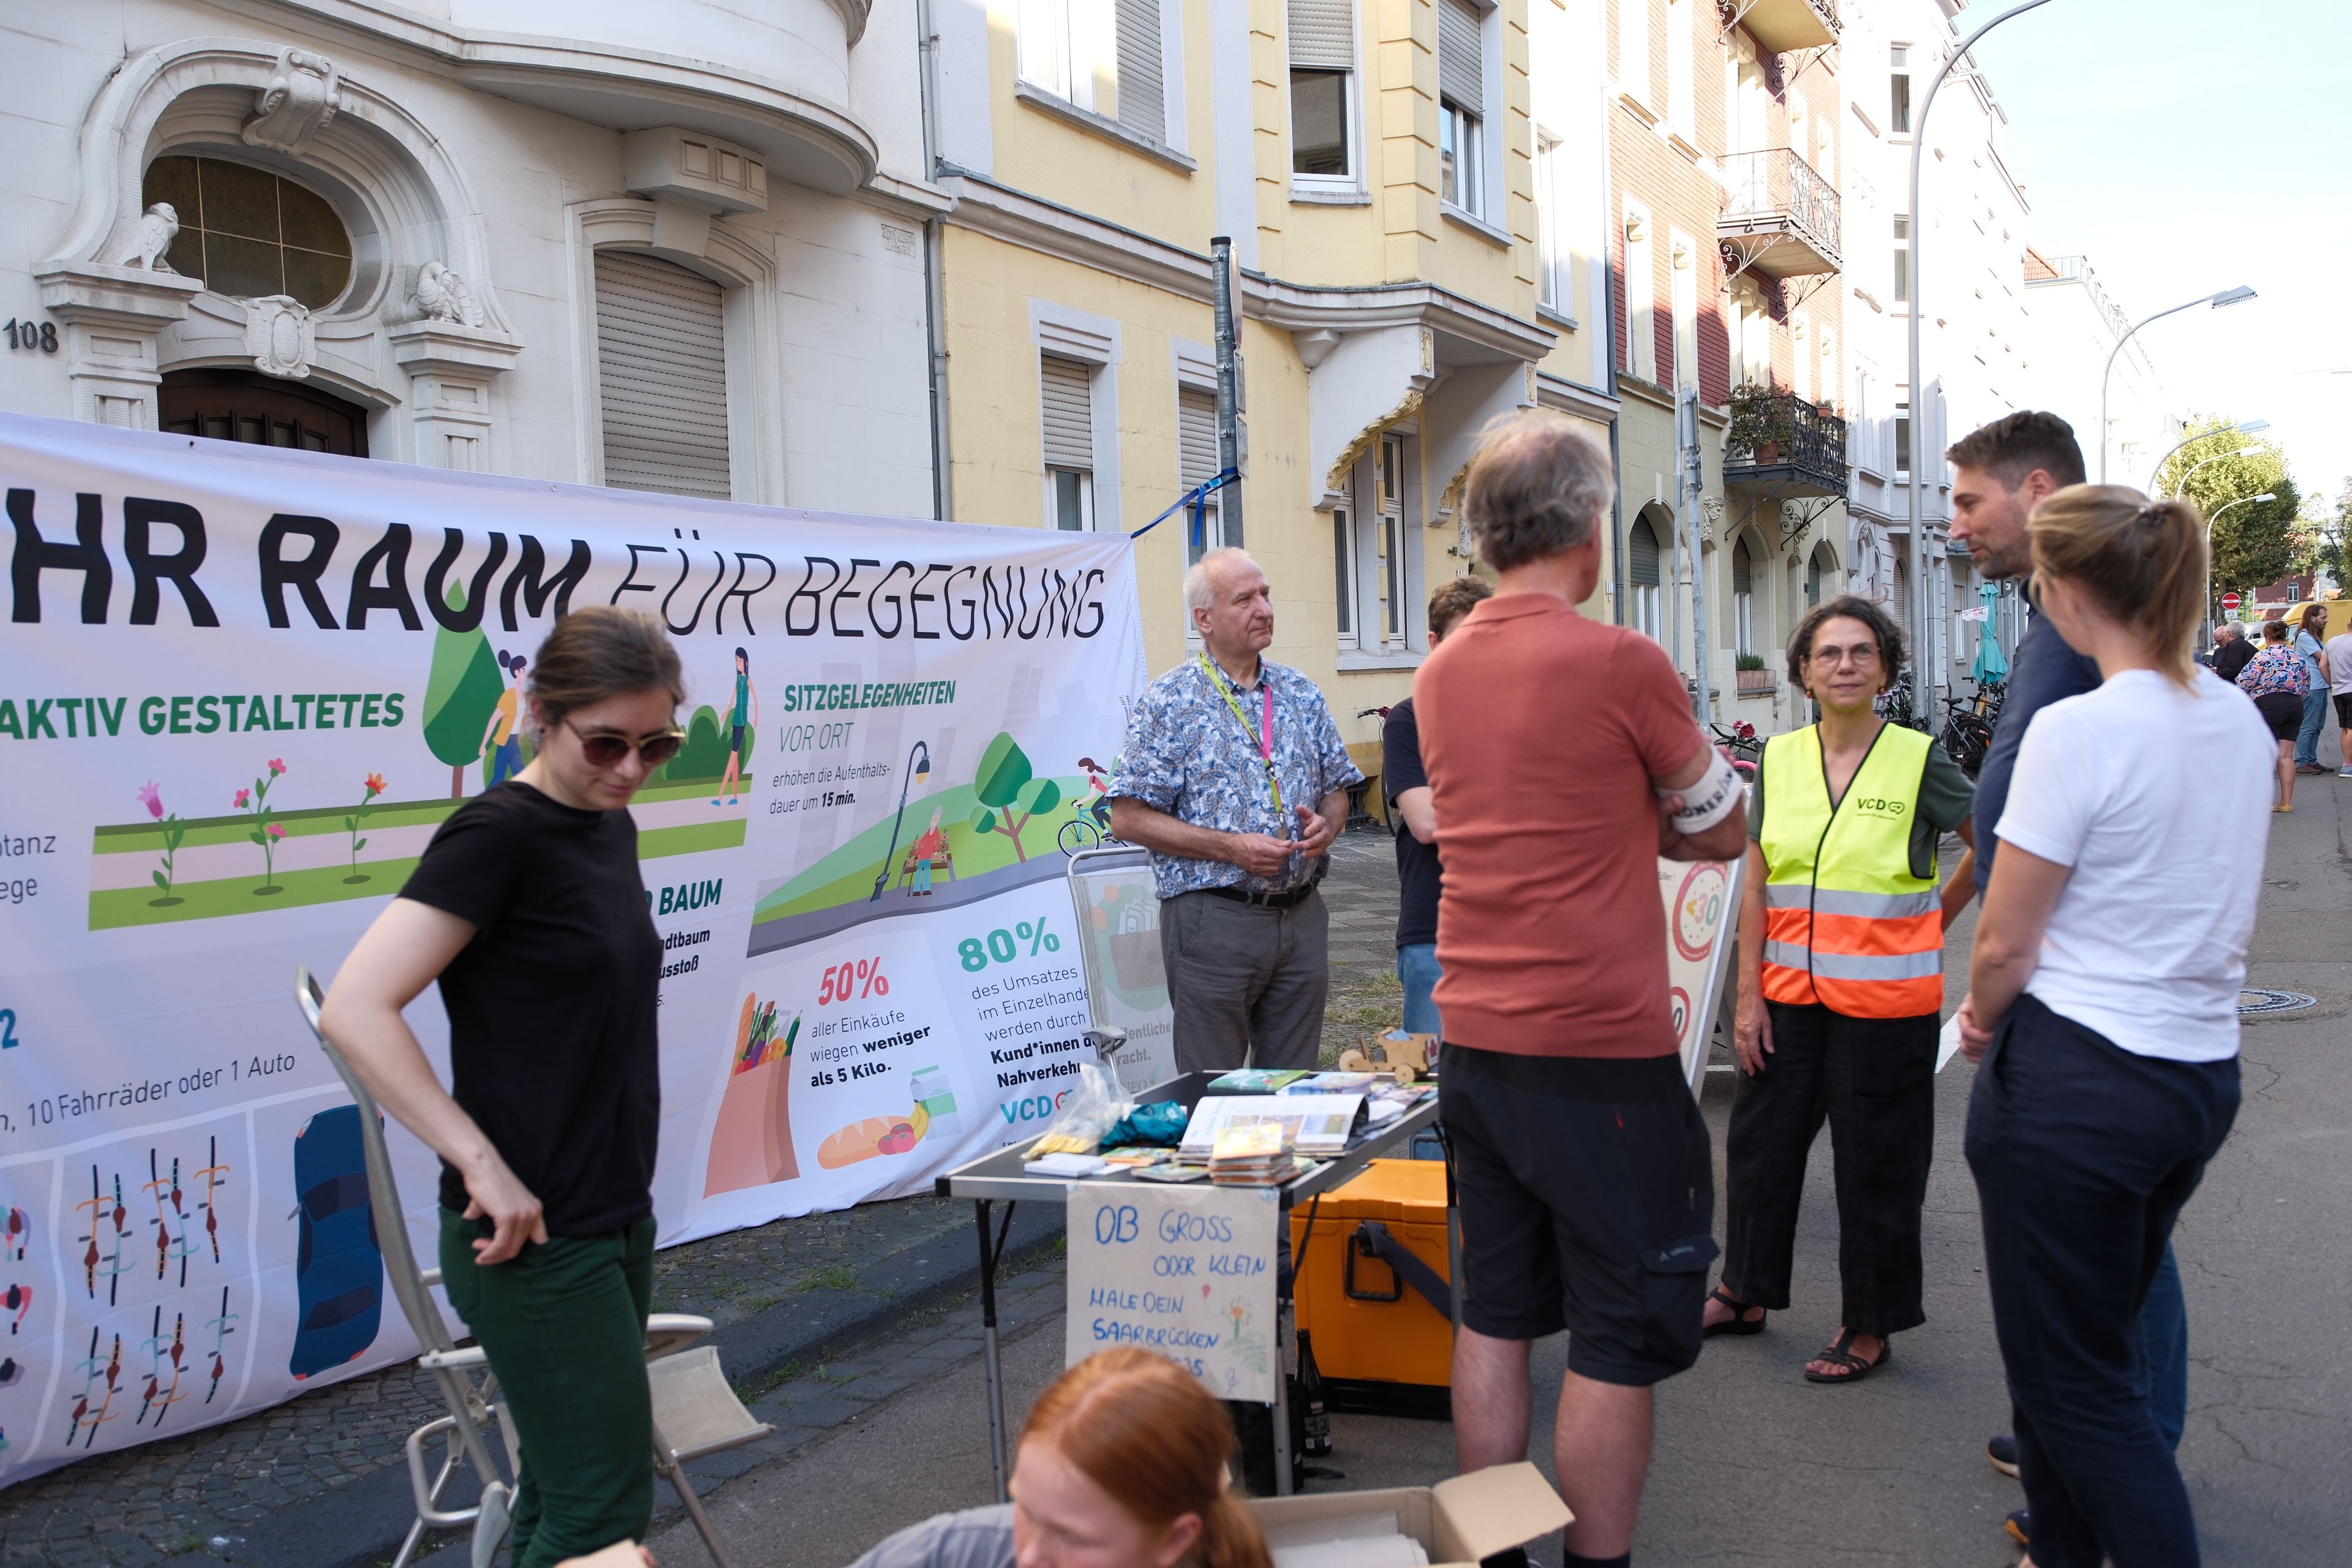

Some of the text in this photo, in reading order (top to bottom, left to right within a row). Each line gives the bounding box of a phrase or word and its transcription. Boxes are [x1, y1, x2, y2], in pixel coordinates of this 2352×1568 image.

[2, 317, 59, 353] 108
[6, 488, 1104, 641] HR RAUM FÜR BEGEGNUNG
[783, 680, 956, 712] SITZGELEGENHEITEN
[0, 693, 404, 740] AKTIV GESTALTETES
[780, 722, 854, 753] VOR ORT
[773, 763, 891, 787] erhöhen die Aufenthalts-
[770, 790, 856, 815] dauer um 15 min.
[1858, 798, 1886, 810] VCD
[658, 878, 723, 916] BAUM
[957, 916, 1060, 973] 80%
[818, 956, 889, 1006] 50%
[971, 967, 1078, 1000] des Umsatzes
[0, 1008, 20, 1049] 2
[812, 1011, 905, 1038] aller Einkäufe
[977, 1007, 998, 1021] im
[984, 1011, 1086, 1042] werden durch
[810, 1026, 931, 1062] wiegen weniger
[28, 1099, 53, 1126] 10
[58, 1079, 172, 1120] Fahrräder
[179, 1067, 222, 1095] oder
[231, 1060, 239, 1082] 1
[248, 1054, 295, 1079] Auto
[810, 1062, 892, 1087] als 5 Kilo.
[1000, 1095, 1052, 1125] VCD
[1095, 1204, 1233, 1245] OB GROSS
[1153, 1253, 1267, 1277] ODER KLEIN
[1142, 1290, 1185, 1314] DEIN
[1092, 1317, 1219, 1350] SAARBRÜCKEN
